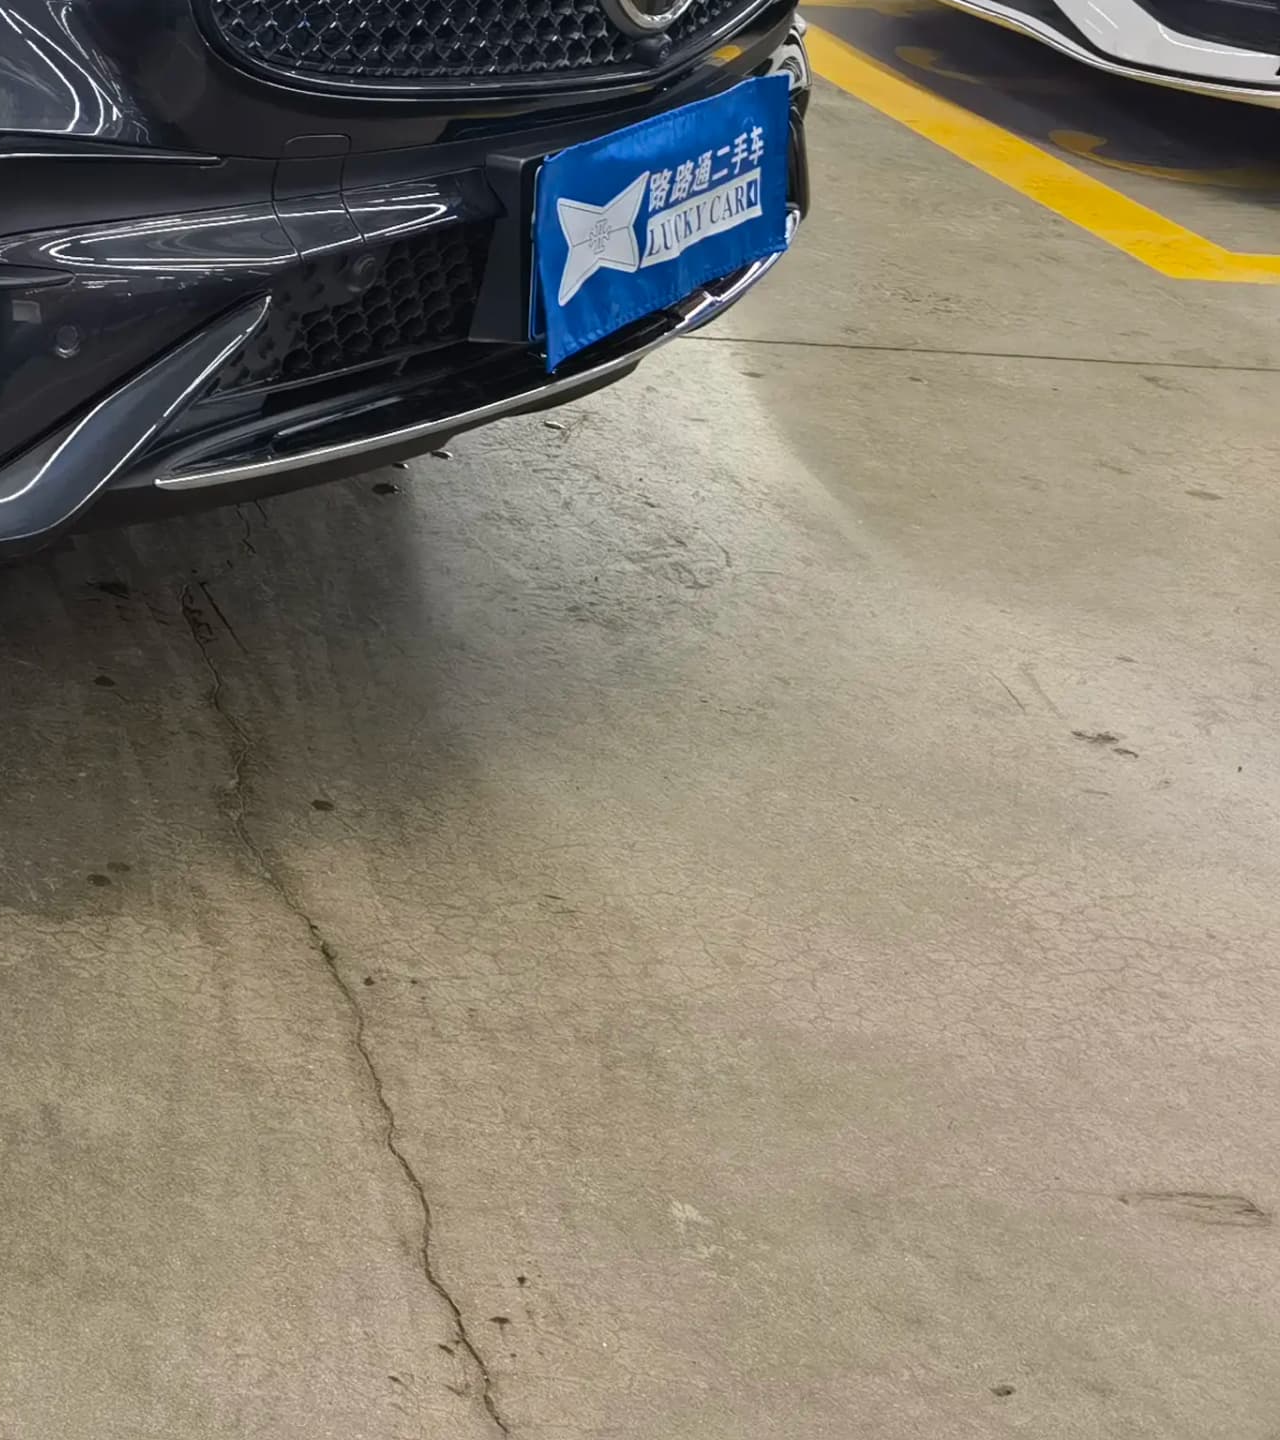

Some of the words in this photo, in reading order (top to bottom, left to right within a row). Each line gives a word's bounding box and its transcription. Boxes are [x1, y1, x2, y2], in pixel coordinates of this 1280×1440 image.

[648, 125, 764, 213] 路路通二手车
[645, 201, 707, 258] LUCKY
[709, 185, 746, 225] CAR
